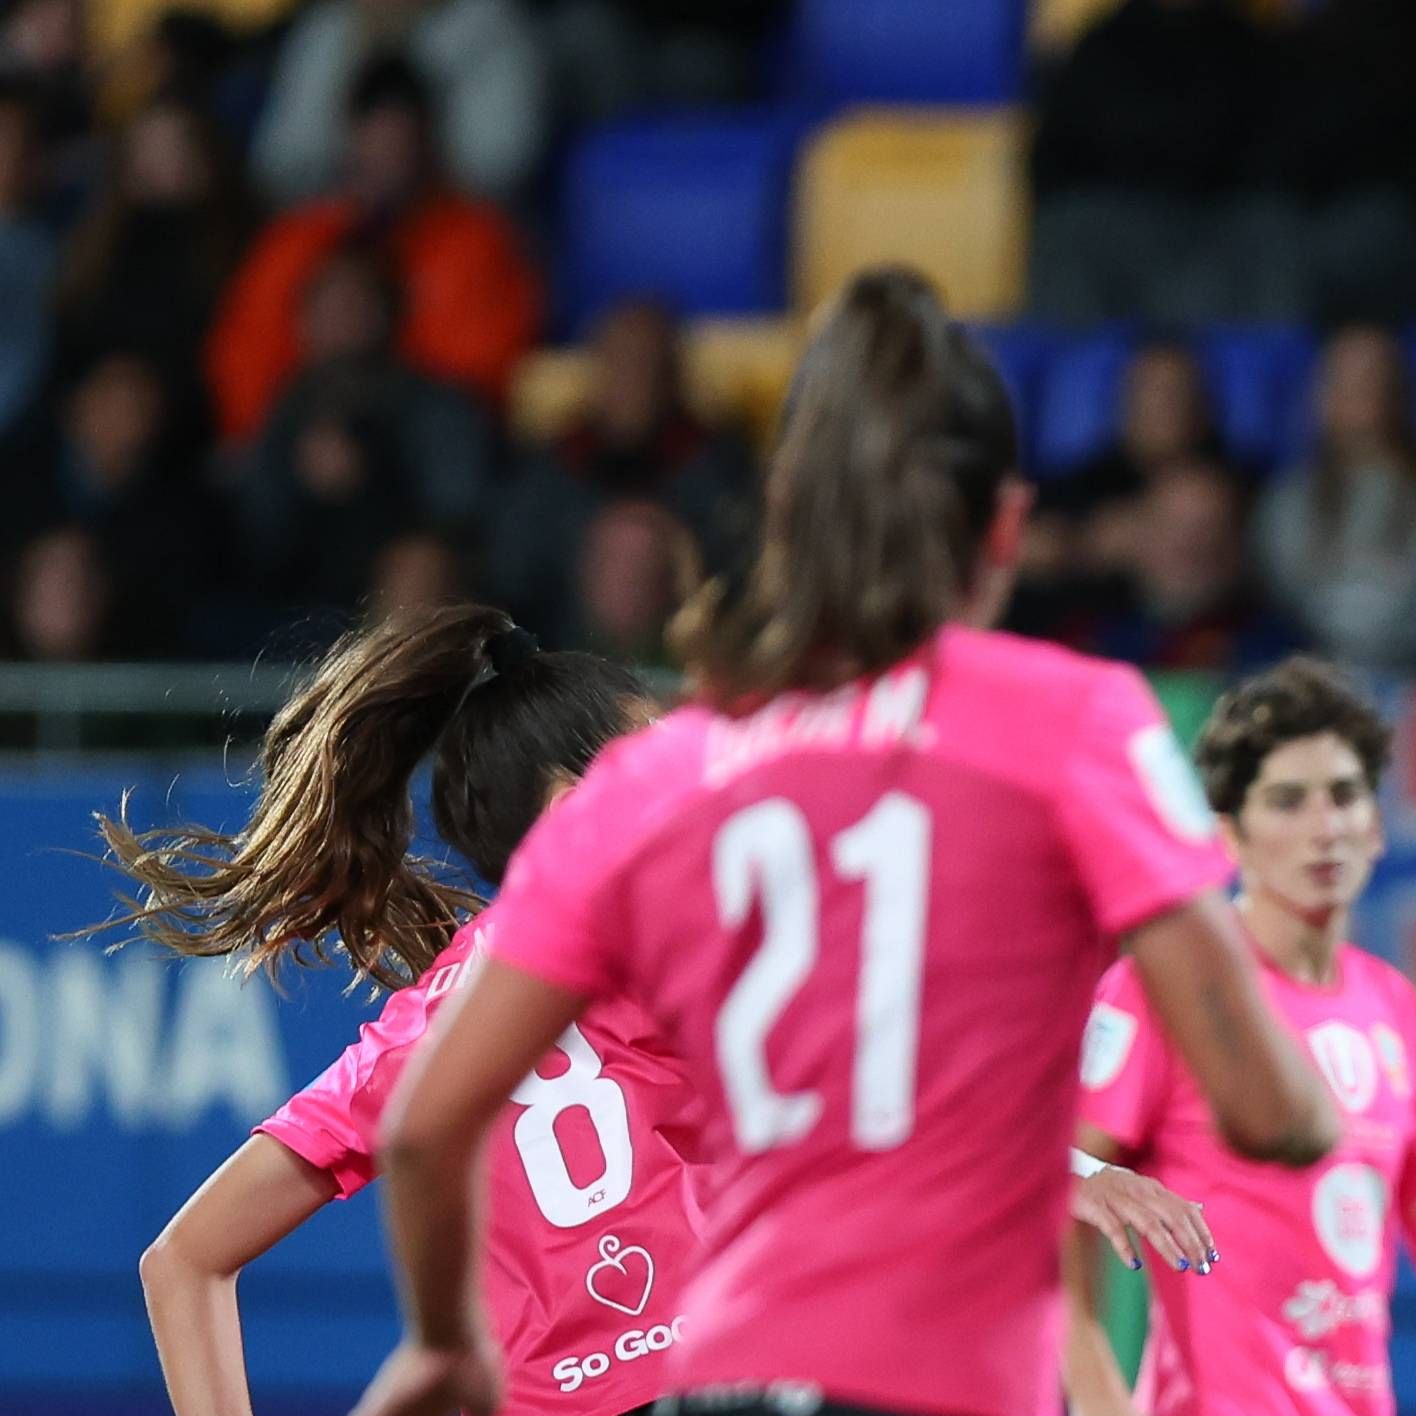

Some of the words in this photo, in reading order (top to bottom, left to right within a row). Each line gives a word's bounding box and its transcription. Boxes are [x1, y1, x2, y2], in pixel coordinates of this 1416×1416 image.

[711, 790, 934, 1155] 21
[509, 1021, 633, 1228] 8
[552, 1352, 610, 1393] So
[614, 1314, 688, 1362] Goo
